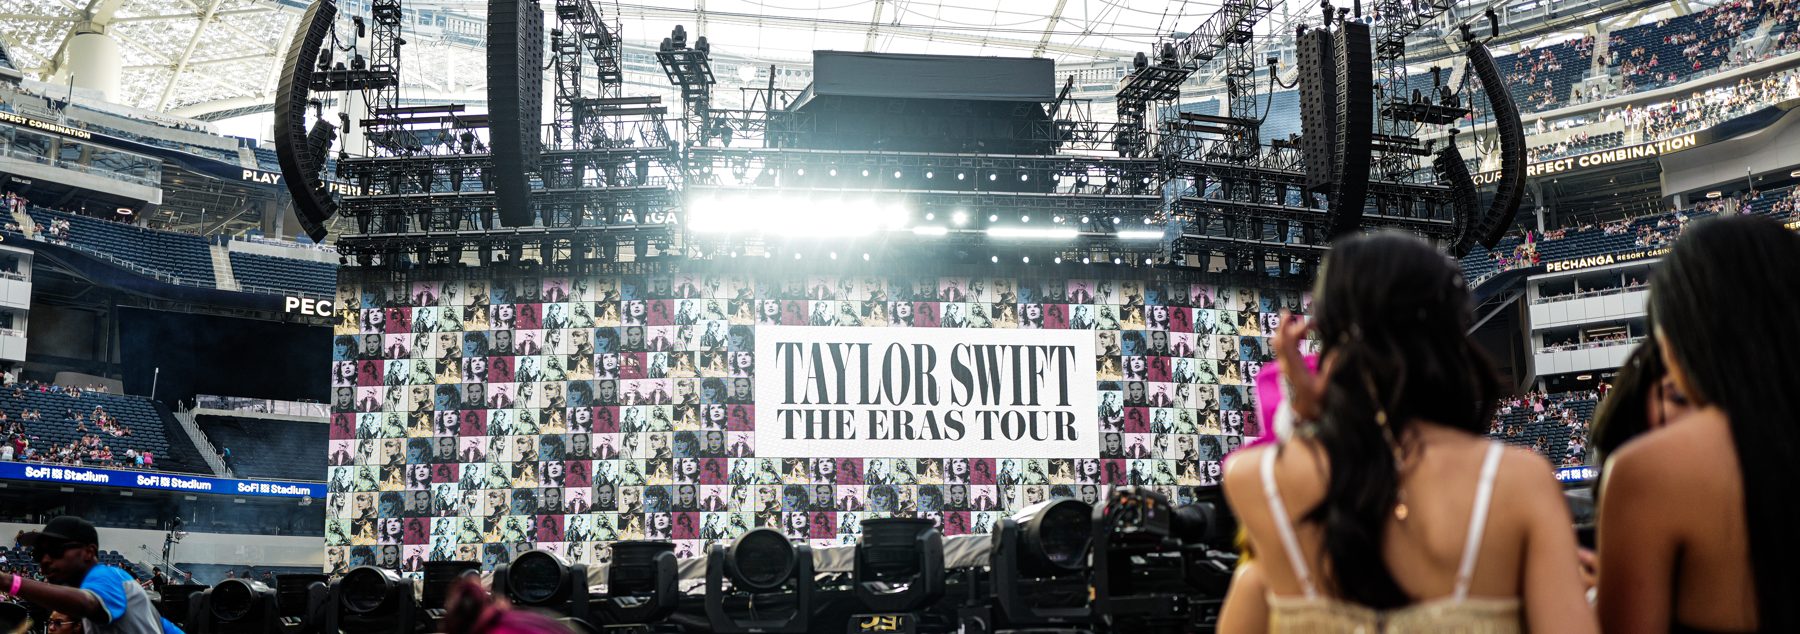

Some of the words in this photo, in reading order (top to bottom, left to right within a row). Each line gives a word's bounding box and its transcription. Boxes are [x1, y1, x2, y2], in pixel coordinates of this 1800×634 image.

[29, 119, 91, 139] COMBINATION
[1579, 134, 1696, 167] COMBINATION
[243, 170, 281, 184] PLAY
[1546, 254, 1615, 273] PECHANGA
[1617, 251, 1646, 261] RESORT
[775, 341, 940, 407] TAYLOR
[950, 342, 1077, 407] SWIFT
[776, 409, 856, 441] THE
[865, 410, 966, 441] ERAS
[975, 410, 1079, 441] TOUR
[25, 466, 51, 479] SoFi
[64, 470, 109, 483] Stadium
[136, 474, 160, 487] SoFi
[171, 477, 212, 491] Stadium
[237, 482, 259, 493] SoFi
[270, 485, 311, 496] Stadium
